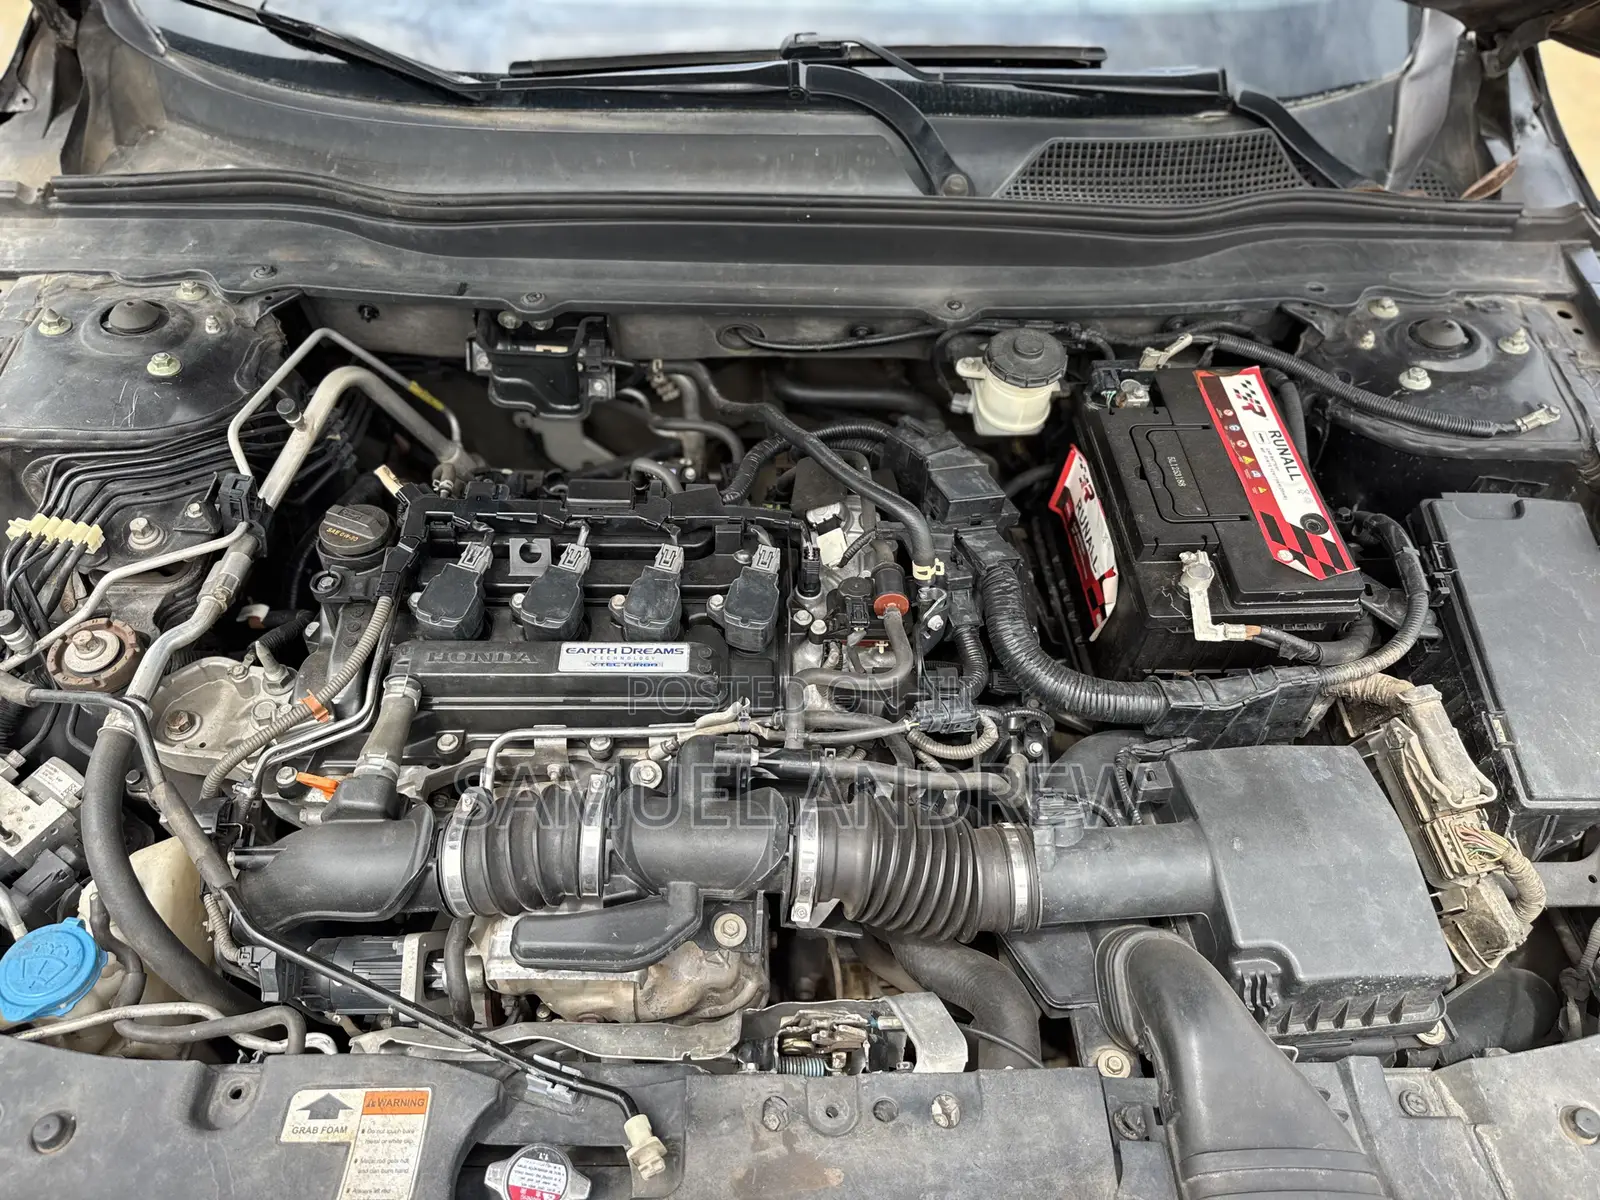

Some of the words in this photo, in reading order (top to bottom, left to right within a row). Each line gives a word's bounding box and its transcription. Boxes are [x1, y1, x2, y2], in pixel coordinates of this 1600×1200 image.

[1267, 429, 1302, 482] RUNALL
[326, 527, 341, 536] SAE
[1075, 497, 1099, 574] RUNALL
[565, 647, 617, 655] EARTH
[620, 646, 684, 655] DREAMS
[425, 650, 539, 664] HONDA
[377, 1098, 425, 1108] WARNING
[291, 1126, 319, 1135] GRAB
[320, 1125, 348, 1134] FOAM
